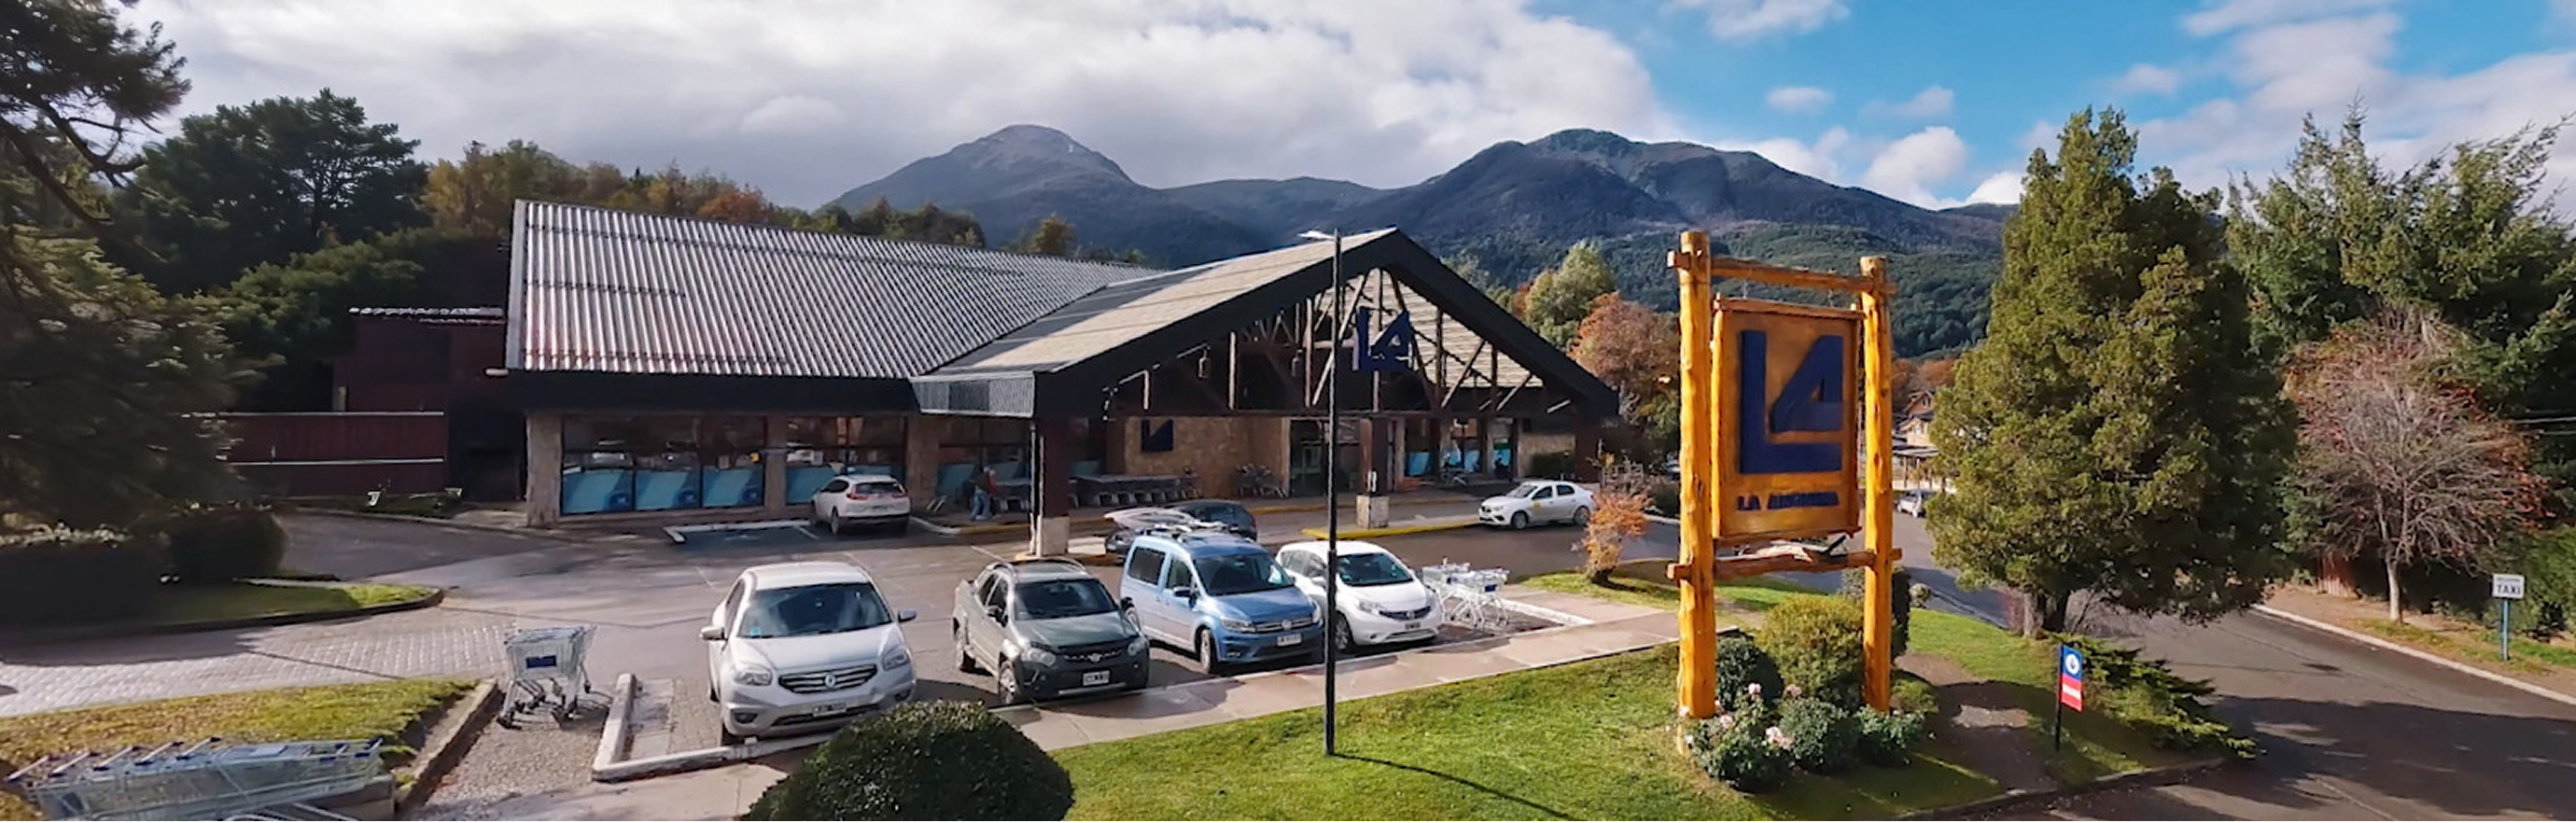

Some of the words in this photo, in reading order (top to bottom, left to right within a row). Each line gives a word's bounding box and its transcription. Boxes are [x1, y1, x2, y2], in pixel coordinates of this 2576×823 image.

[1739, 329, 1843, 475] LA
[1737, 495, 1761, 511] LA
[2497, 584, 2522, 594] TAXI
